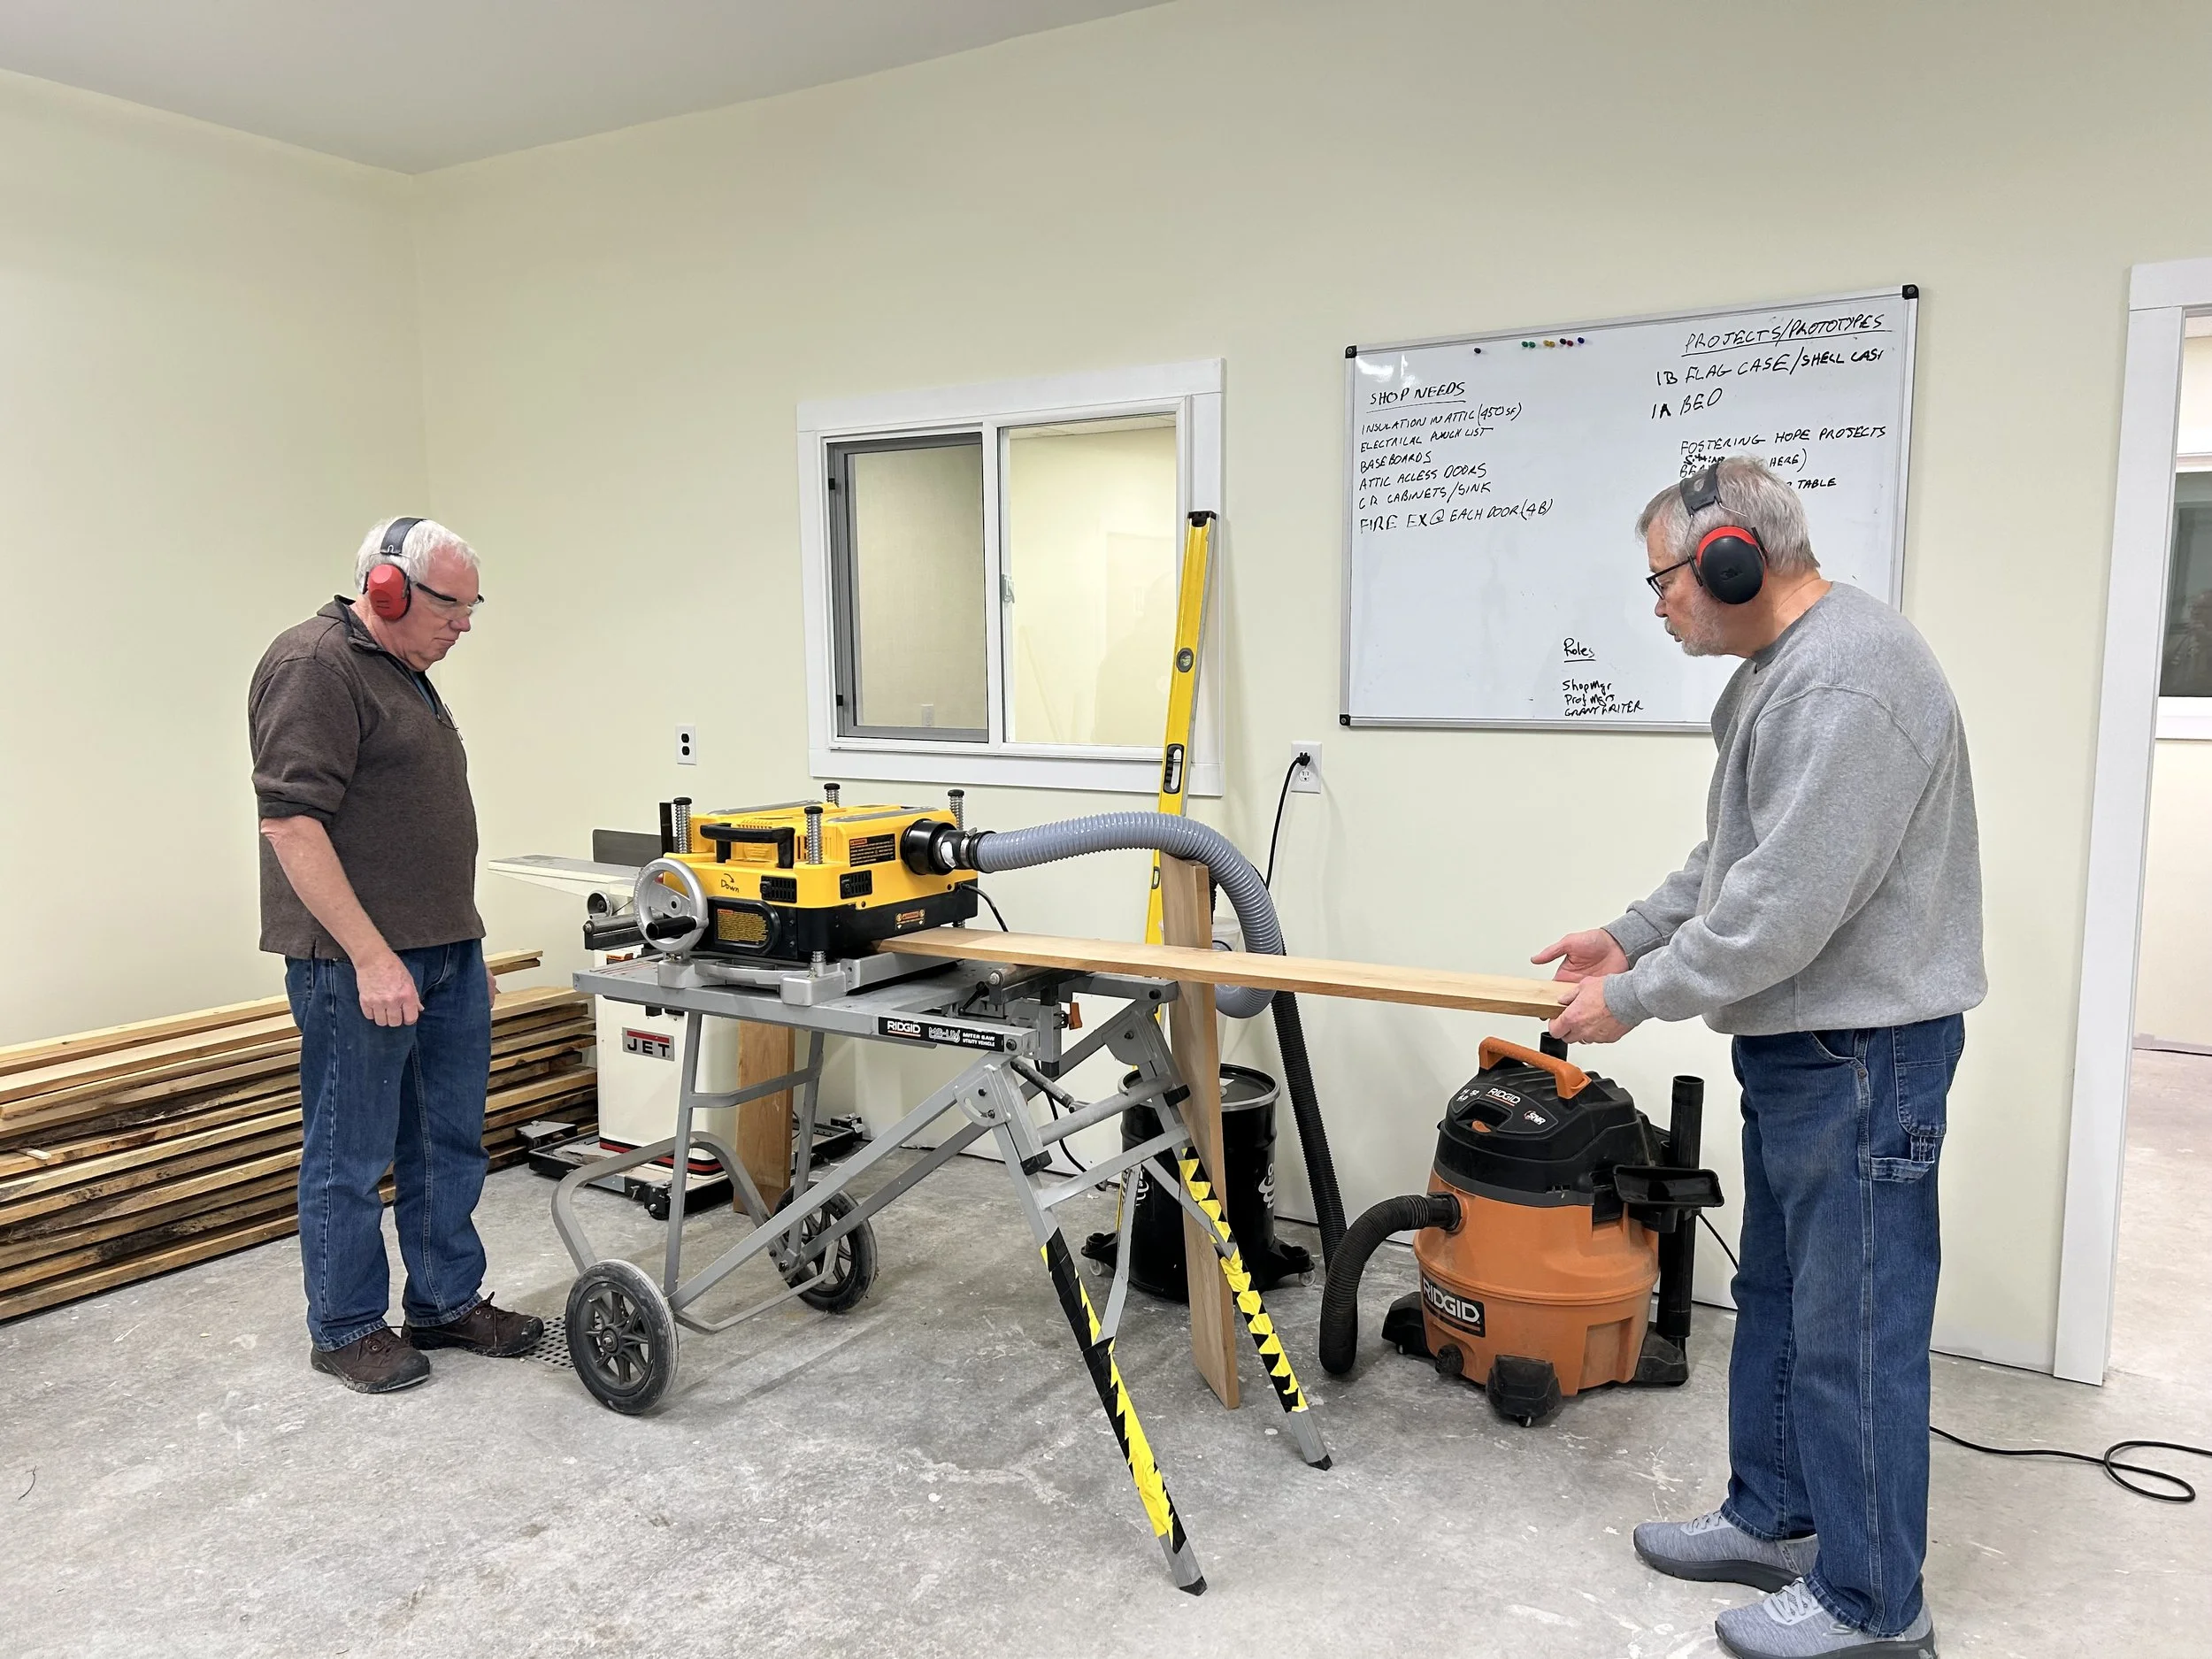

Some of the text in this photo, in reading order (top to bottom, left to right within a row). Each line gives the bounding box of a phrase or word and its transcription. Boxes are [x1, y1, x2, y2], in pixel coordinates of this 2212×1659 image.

[1685, 313, 1885, 353] PROJECTS/PROTOTYPES
[1685, 363, 1733, 384] FLAG
[1369, 381, 1466, 405] SHOP NEEDS
[1361, 417, 1427, 435] INSULATION
[1443, 410, 1475, 424] ATTIC
[1464, 426, 1494, 438] LIST
[1680, 426, 1886, 455] FOSTERING HOPE PROJECTS
[1360, 450, 1432, 473] BASEBOARDS
[1359, 475, 1391, 491] ATTIC
[1444, 463, 1487, 479] DOORS
[1797, 477, 1837, 489] TABLE
[1360, 514, 1398, 534] FIRE
[1449, 507, 1484, 522] EACH
[1563, 637, 1595, 658] Roles
[720, 879, 740, 894] Down
[887, 1019, 921, 1033] RIDGID
[626, 1038, 670, 1057] JET
[1486, 1087, 1521, 1105] RIDGID
[1423, 1277, 1480, 1324] RIDGID
